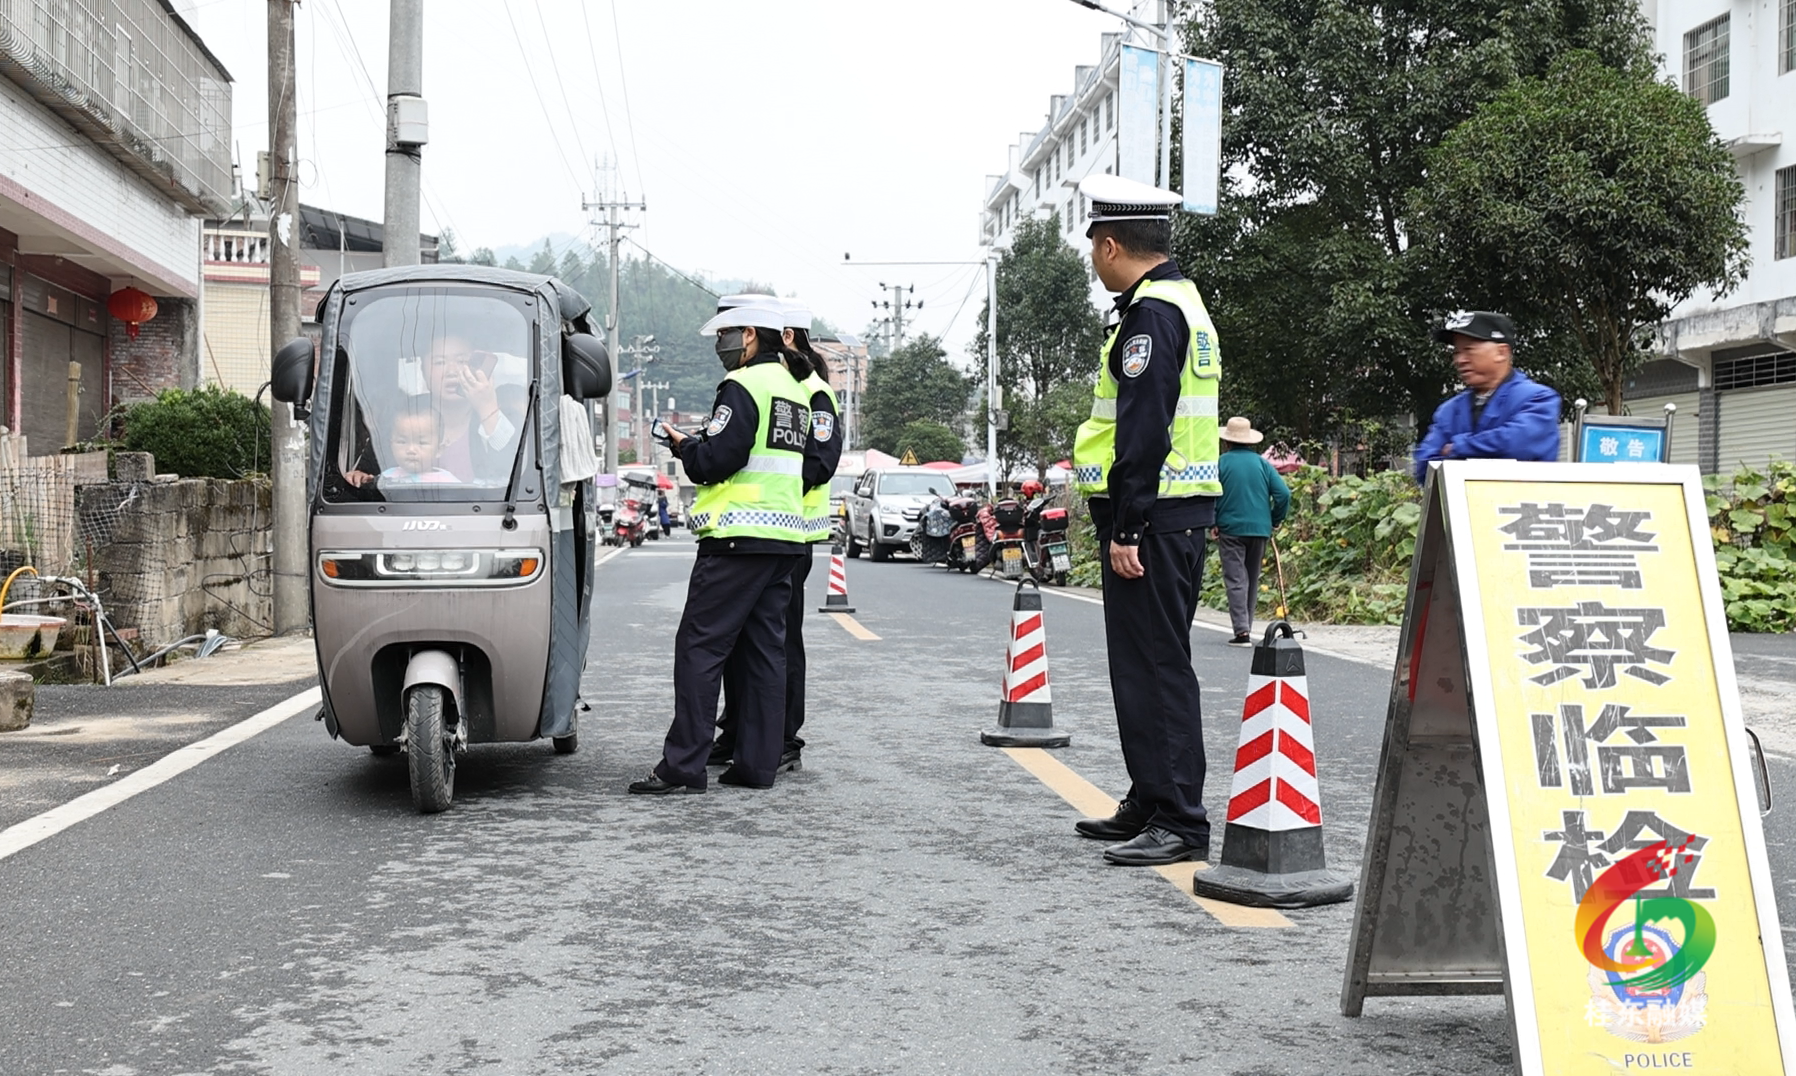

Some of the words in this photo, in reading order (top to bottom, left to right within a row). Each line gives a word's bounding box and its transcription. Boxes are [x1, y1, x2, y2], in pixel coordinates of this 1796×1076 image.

[1600, 436, 1645, 458] 敬告
[1498, 502, 1717, 905] 警察临检
[1624, 1052, 1693, 1069] POLICE
